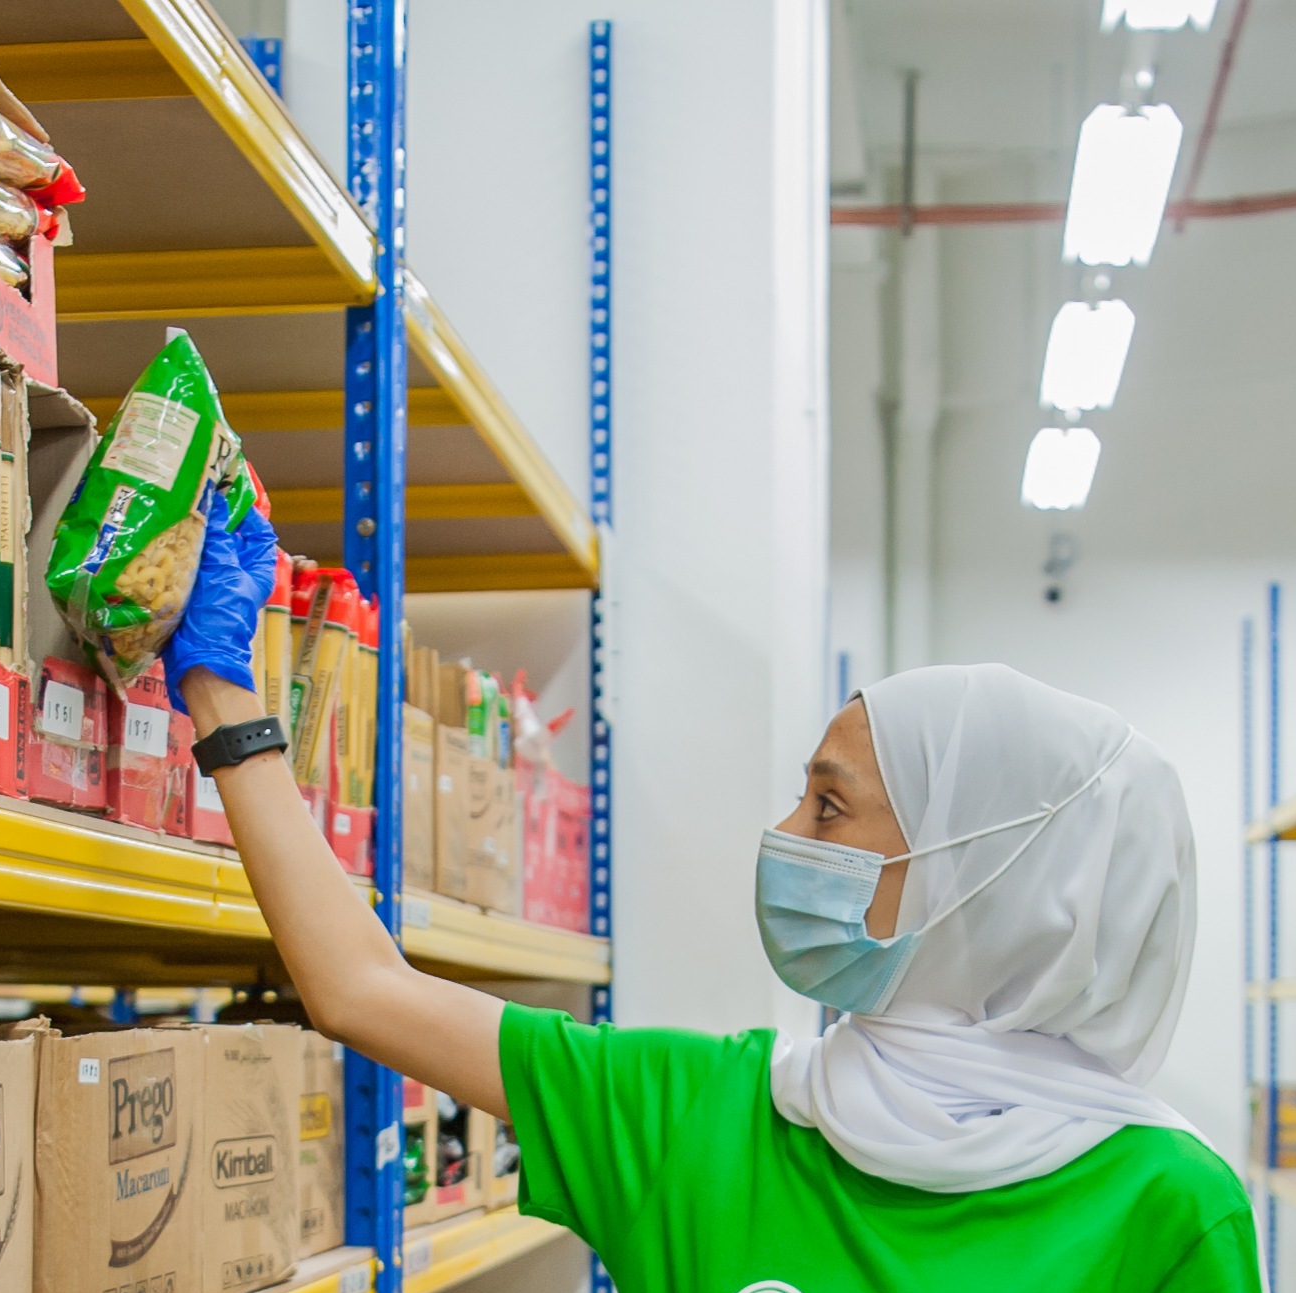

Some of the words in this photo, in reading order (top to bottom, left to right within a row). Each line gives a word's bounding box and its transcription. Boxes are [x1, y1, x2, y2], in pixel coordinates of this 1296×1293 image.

[0, 474, 9, 550] SPAGHETTI
[112, 1076, 175, 1145] Prego
[116, 1155, 170, 1201] Macaroni
[216, 1145, 274, 1180] Kimball
